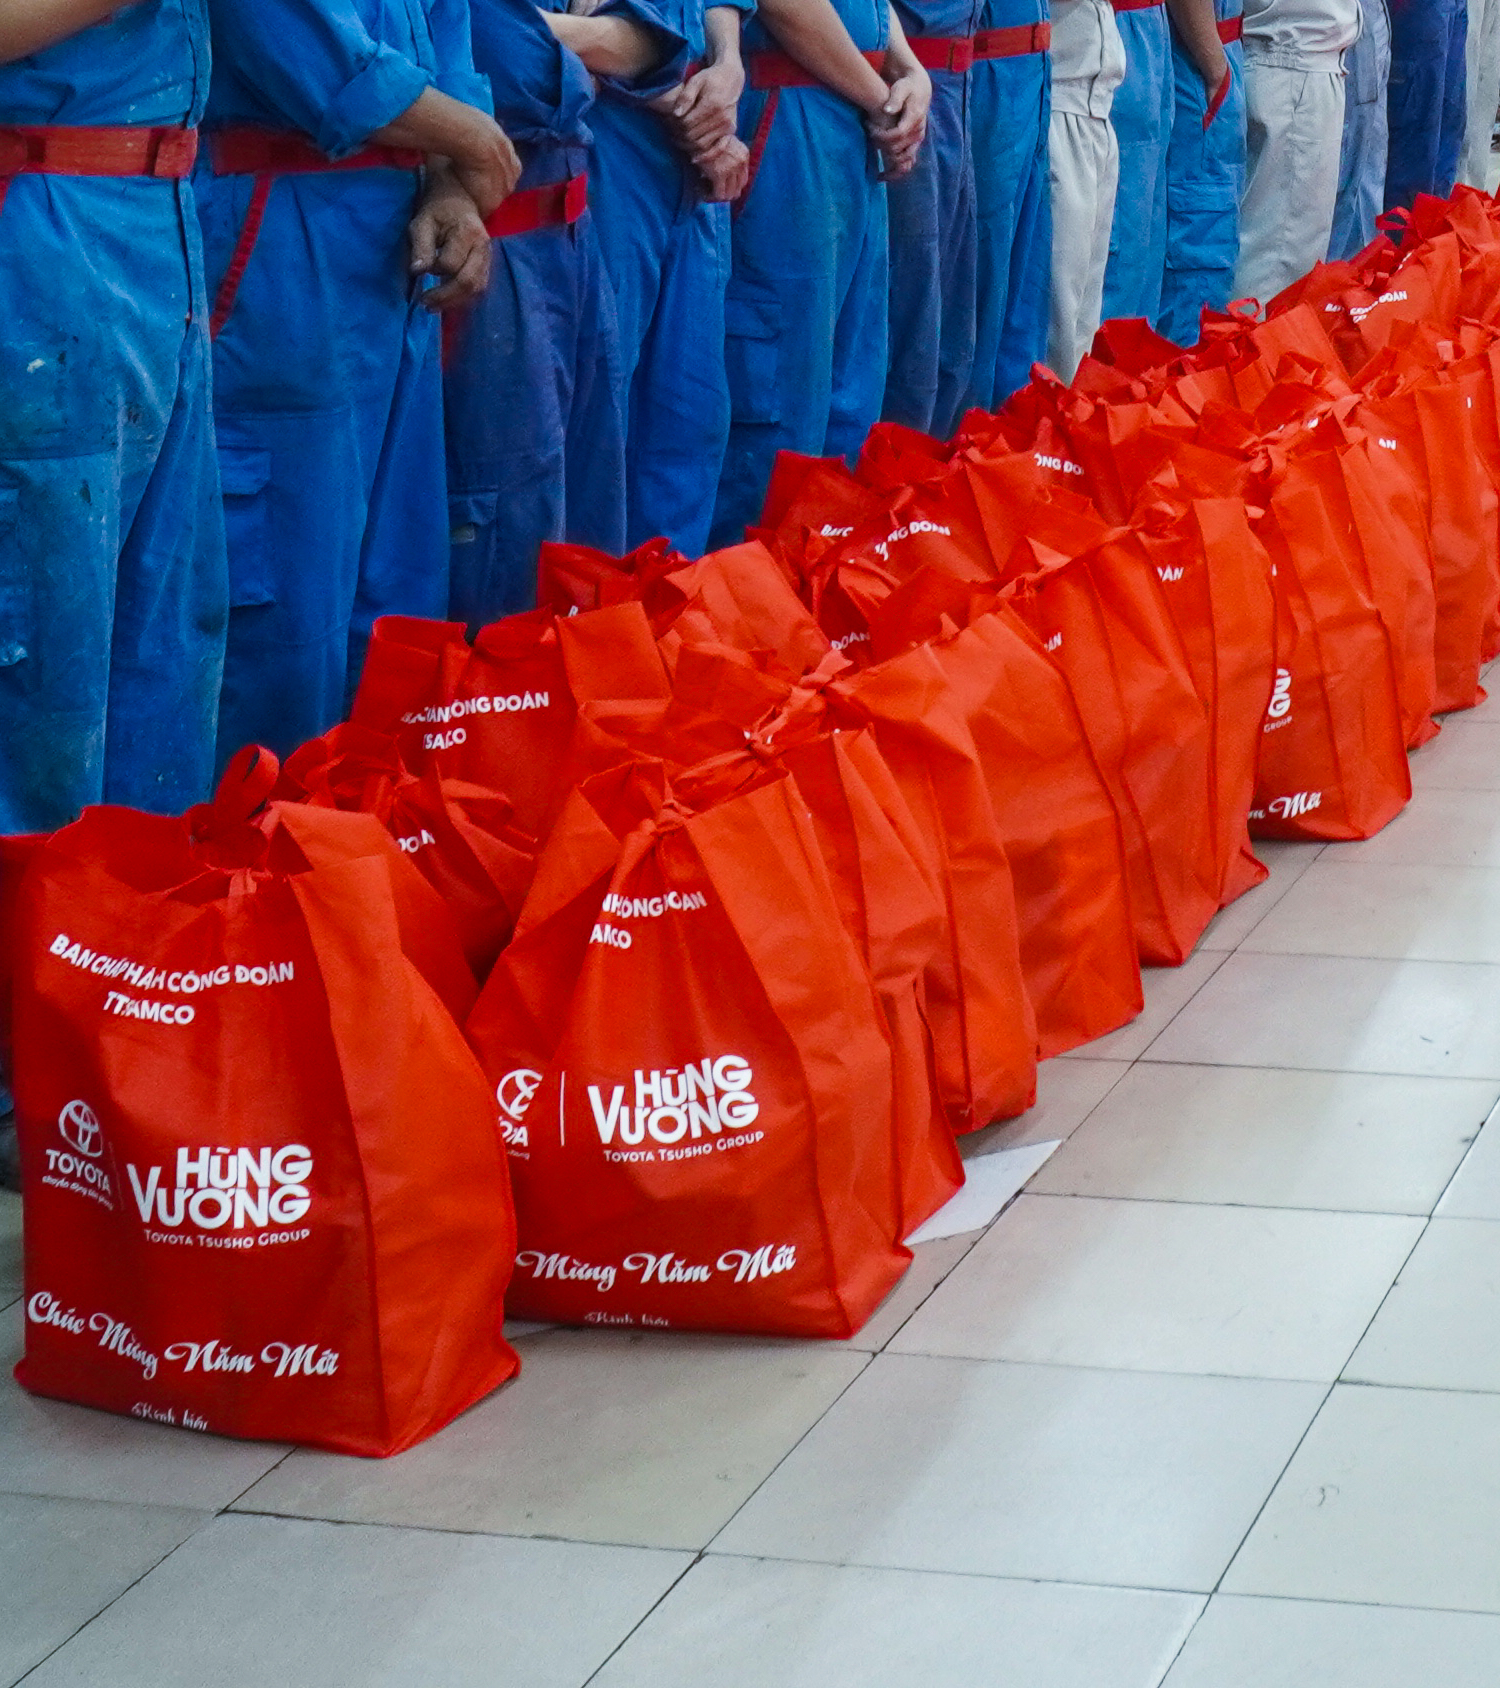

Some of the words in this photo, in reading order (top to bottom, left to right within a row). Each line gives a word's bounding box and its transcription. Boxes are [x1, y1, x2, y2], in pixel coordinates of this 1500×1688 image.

[49, 934, 98, 970] BAN
[168, 964, 231, 994] CÔNG
[234, 960, 295, 986] ĐOÀN
[634, 1054, 753, 1108] HÙNG
[587, 1085, 759, 1145] VƯƠNG
[45, 1148, 113, 1194] TOYOTA
[176, 1144, 313, 1190] HÙNG
[603, 1148, 655, 1163] TOYOTA
[658, 1142, 712, 1162] TSUSHO
[716, 1130, 765, 1151] GROUP
[127, 1163, 312, 1229] VƯƠNG
[144, 1228, 194, 1246] TOYOTA
[197, 1233, 254, 1249] TSUSHO
[257, 1228, 311, 1247] GROUP
[515, 1250, 617, 1293] Mừng
[622, 1251, 712, 1285] Năm
[717, 1243, 797, 1283] Mới
[28, 1291, 85, 1335] Chúc
[89, 1312, 159, 1380] Mừng
[164, 1339, 255, 1373] Năm
[260, 1341, 340, 1378] Mới
